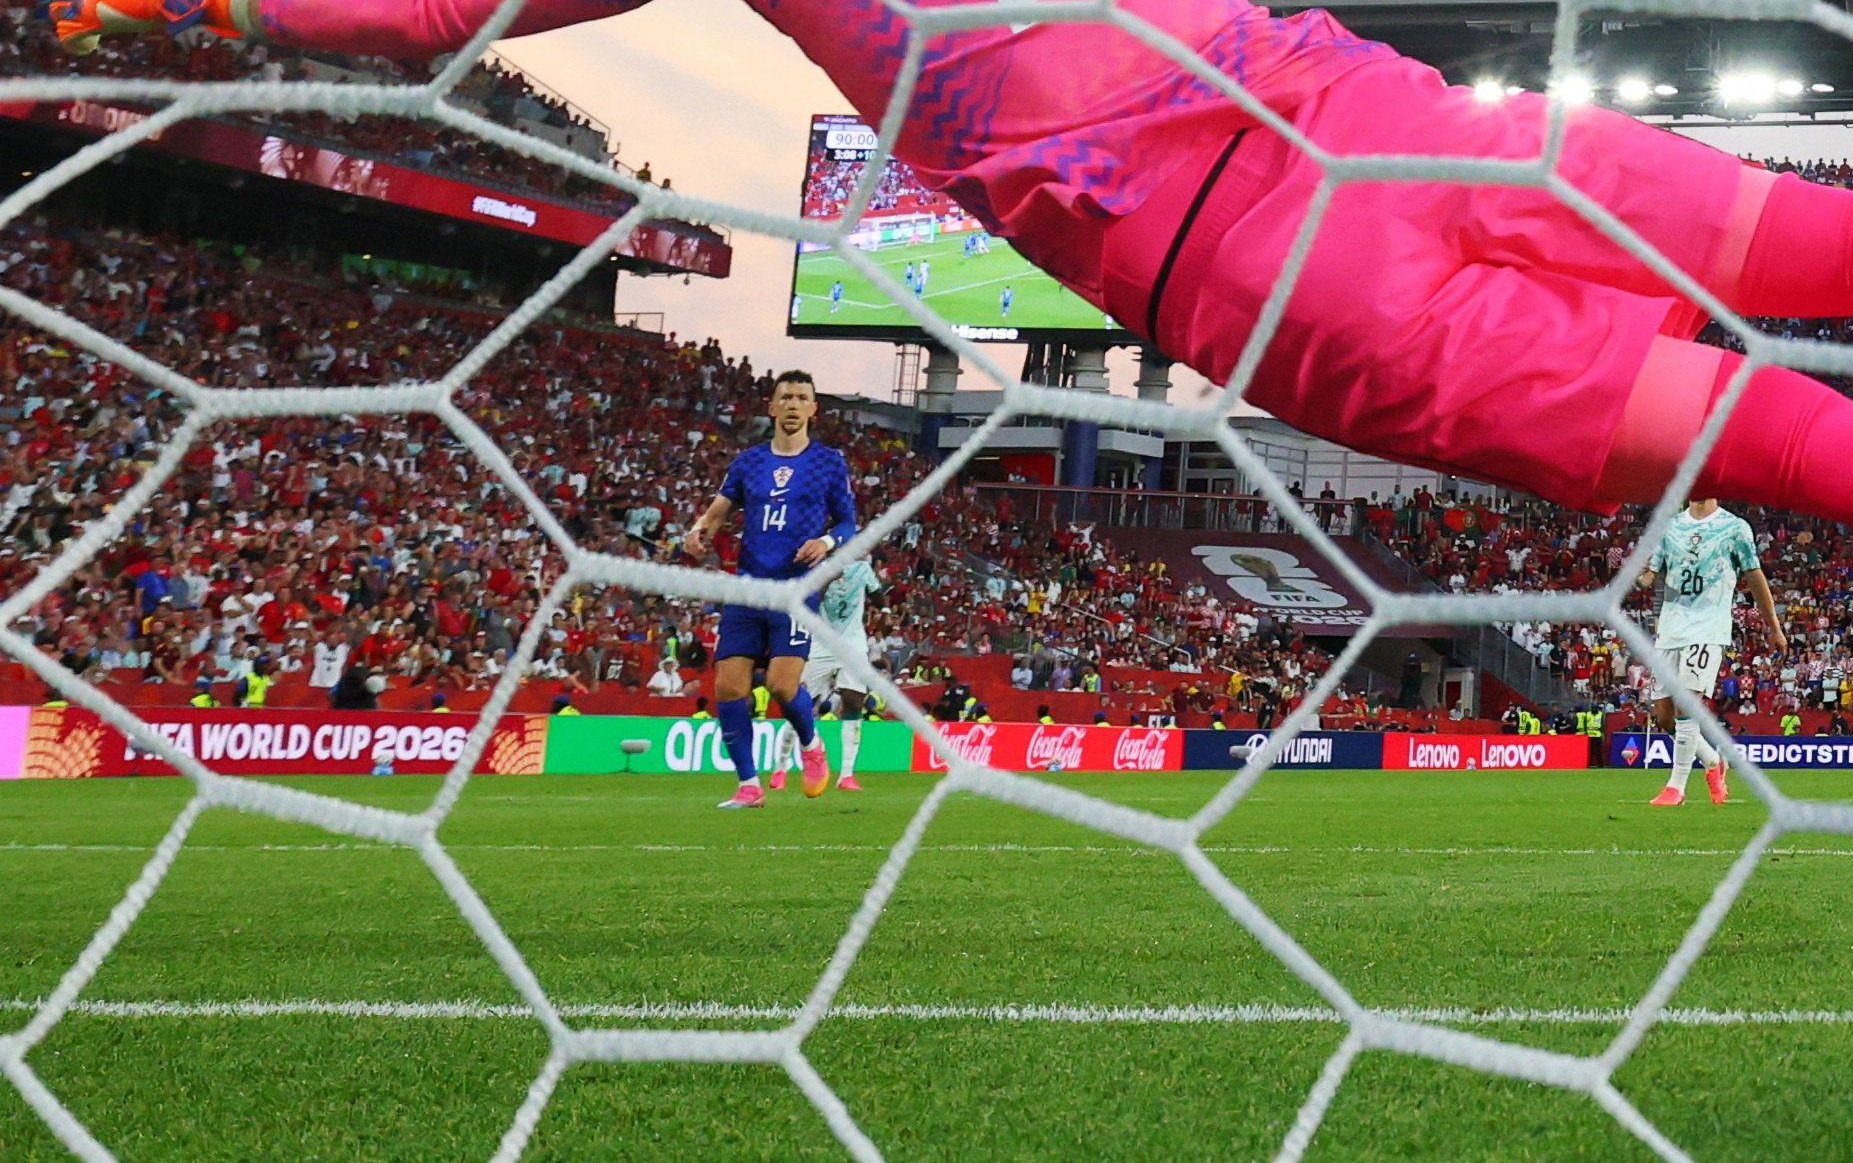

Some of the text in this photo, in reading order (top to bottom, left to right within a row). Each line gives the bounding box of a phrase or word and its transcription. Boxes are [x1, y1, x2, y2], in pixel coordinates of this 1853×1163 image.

[762, 504, 787, 532] 14
[1681, 568, 1704, 596] 26
[838, 601, 848, 619] 2
[1270, 594, 1321, 603] FIFA
[1686, 643, 1710, 670] 26
[201, 723, 312, 761] WORLD
[313, 724, 372, 761] CUP
[371, 725, 468, 762] 2026
[1409, 738, 1460, 768] Lenovo
[1481, 739, 1546, 767] Lenovo
